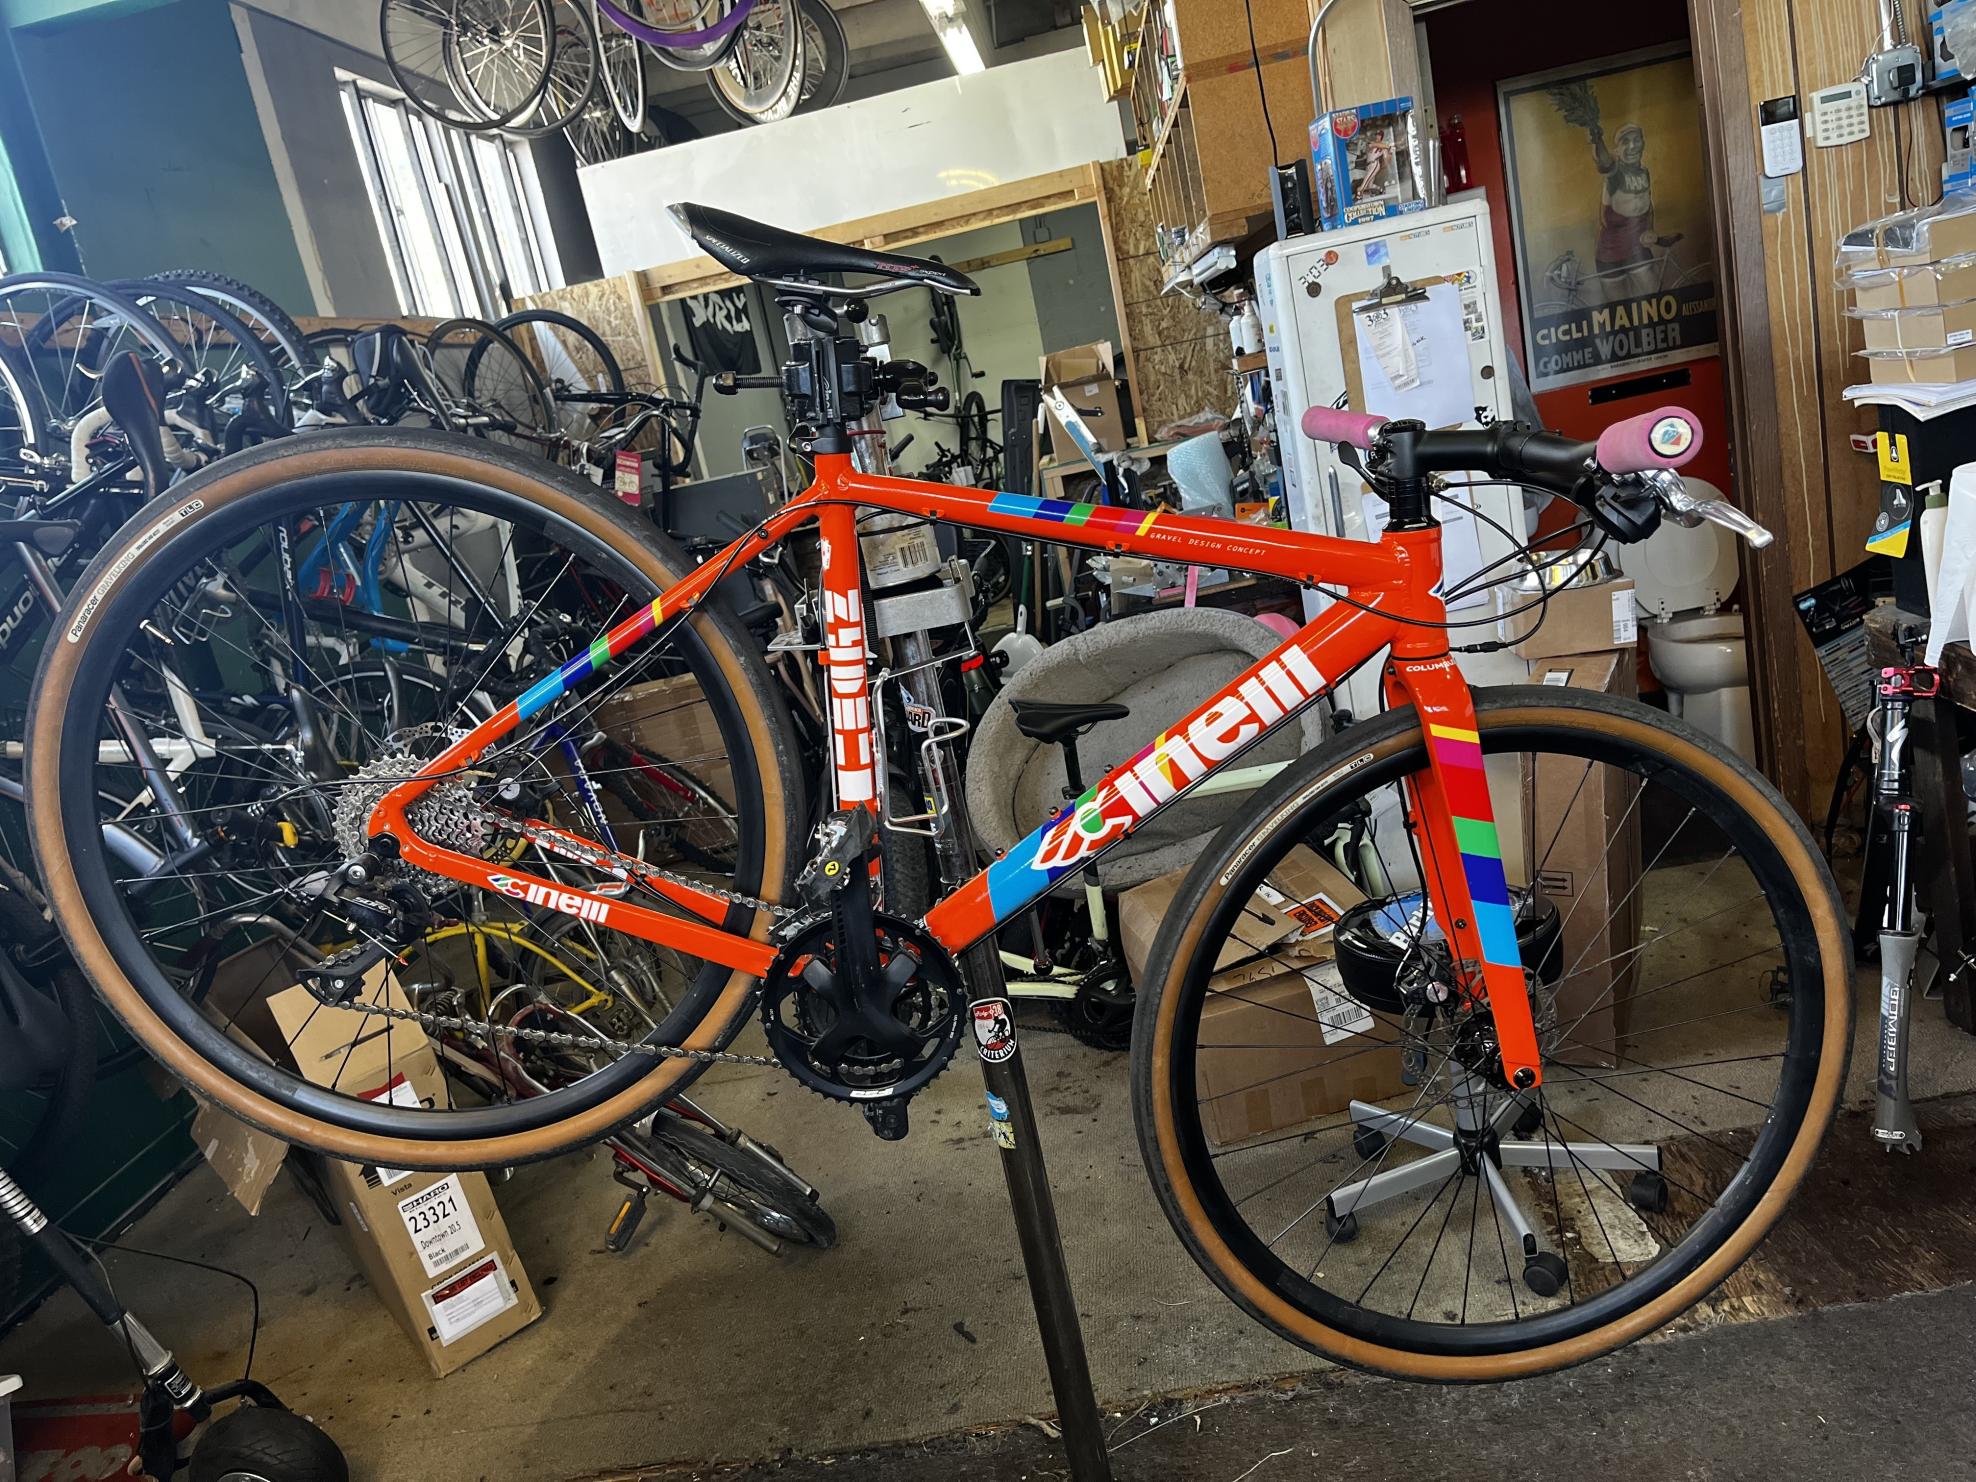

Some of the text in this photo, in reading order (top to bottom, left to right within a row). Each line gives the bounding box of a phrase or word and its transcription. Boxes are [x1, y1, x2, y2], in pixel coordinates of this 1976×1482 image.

[704, 233, 750, 265] SPECIALIZED
[685, 292, 751, 334] SURLY
[1535, 320, 1588, 346] CICLI
[1591, 295, 1678, 335] MAINO
[1594, 322, 1681, 361] WOLBER
[178, 500, 203, 518] TLC
[1149, 531, 1267, 557] GRAVEL DESIGN CONCEPT
[71, 551, 136, 638] Panaracer GRAVELKING
[1406, 658, 1455, 672] COLUMBU
[1224, 800, 1301, 881] Panaracer GRAVELKING
[1886, 985, 1900, 1072] BOMBER
[978, 1037, 1016, 1060] CRITERIUM
[391, 1182, 413, 1197] Vista
[412, 1182, 450, 1207] HARO
[408, 1194, 458, 1235] 23321
[420, 1220, 462, 1251] Downtown 20.5
[428, 1247, 446, 1261] Black
